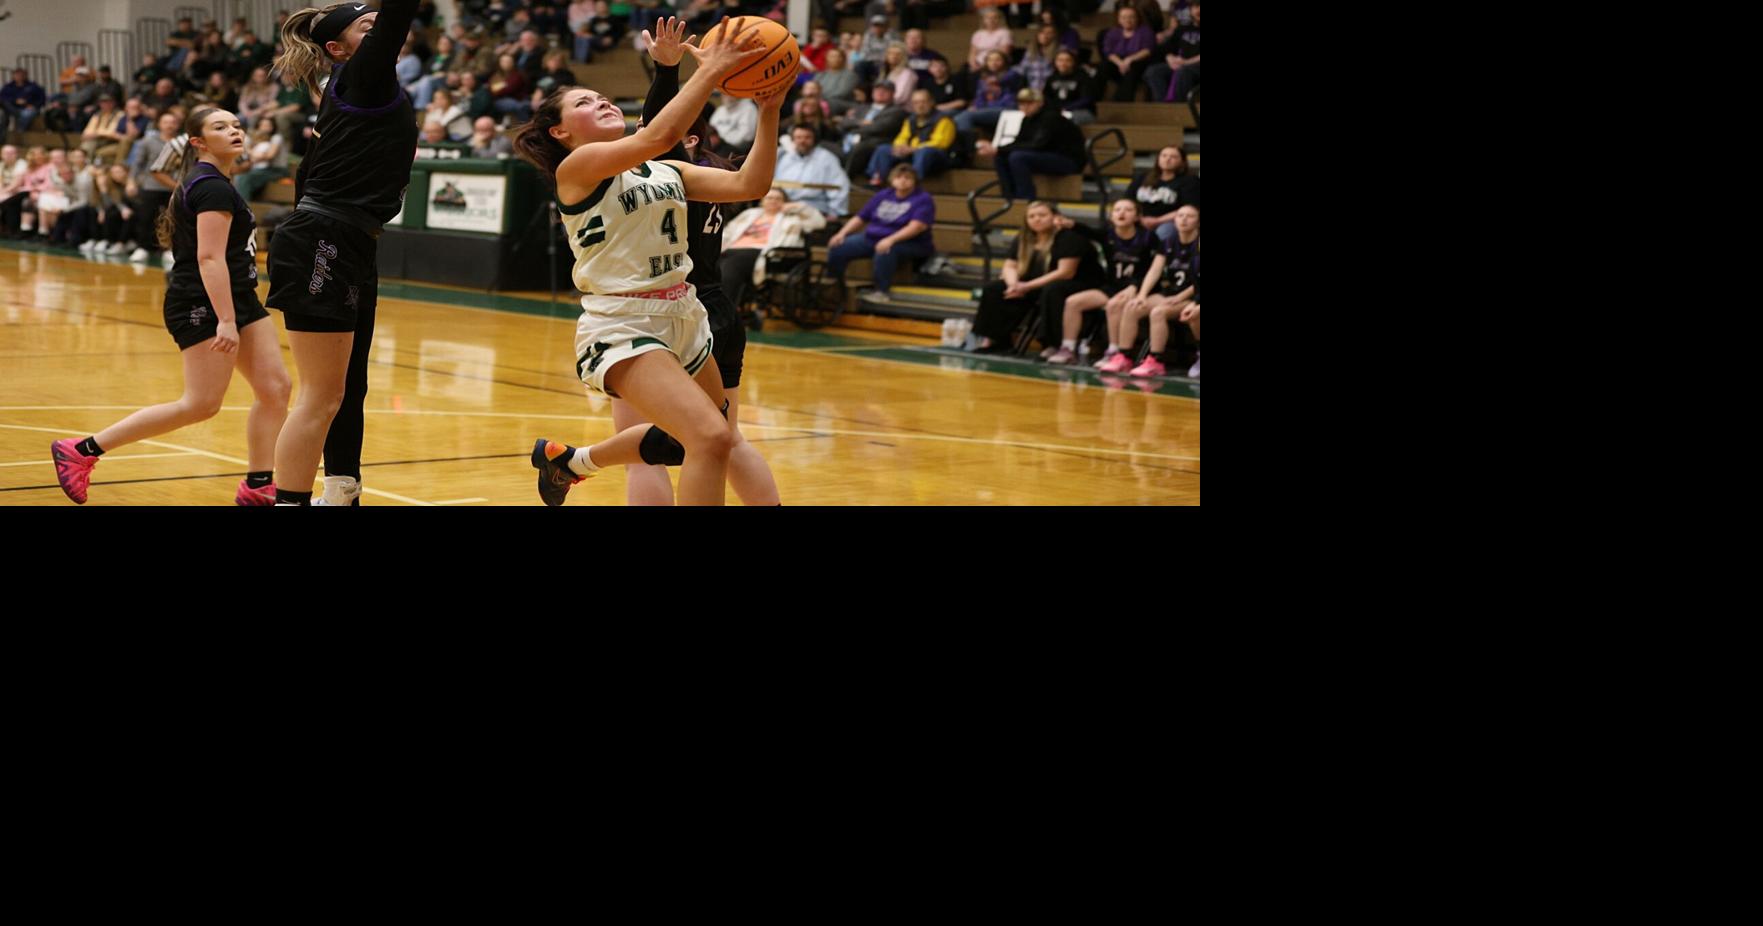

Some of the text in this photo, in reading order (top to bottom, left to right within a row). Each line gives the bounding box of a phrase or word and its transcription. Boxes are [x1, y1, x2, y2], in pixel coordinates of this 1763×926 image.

[661, 207, 678, 245] 4
[702, 200, 723, 234] 25
[309, 240, 337, 295] Raiders
